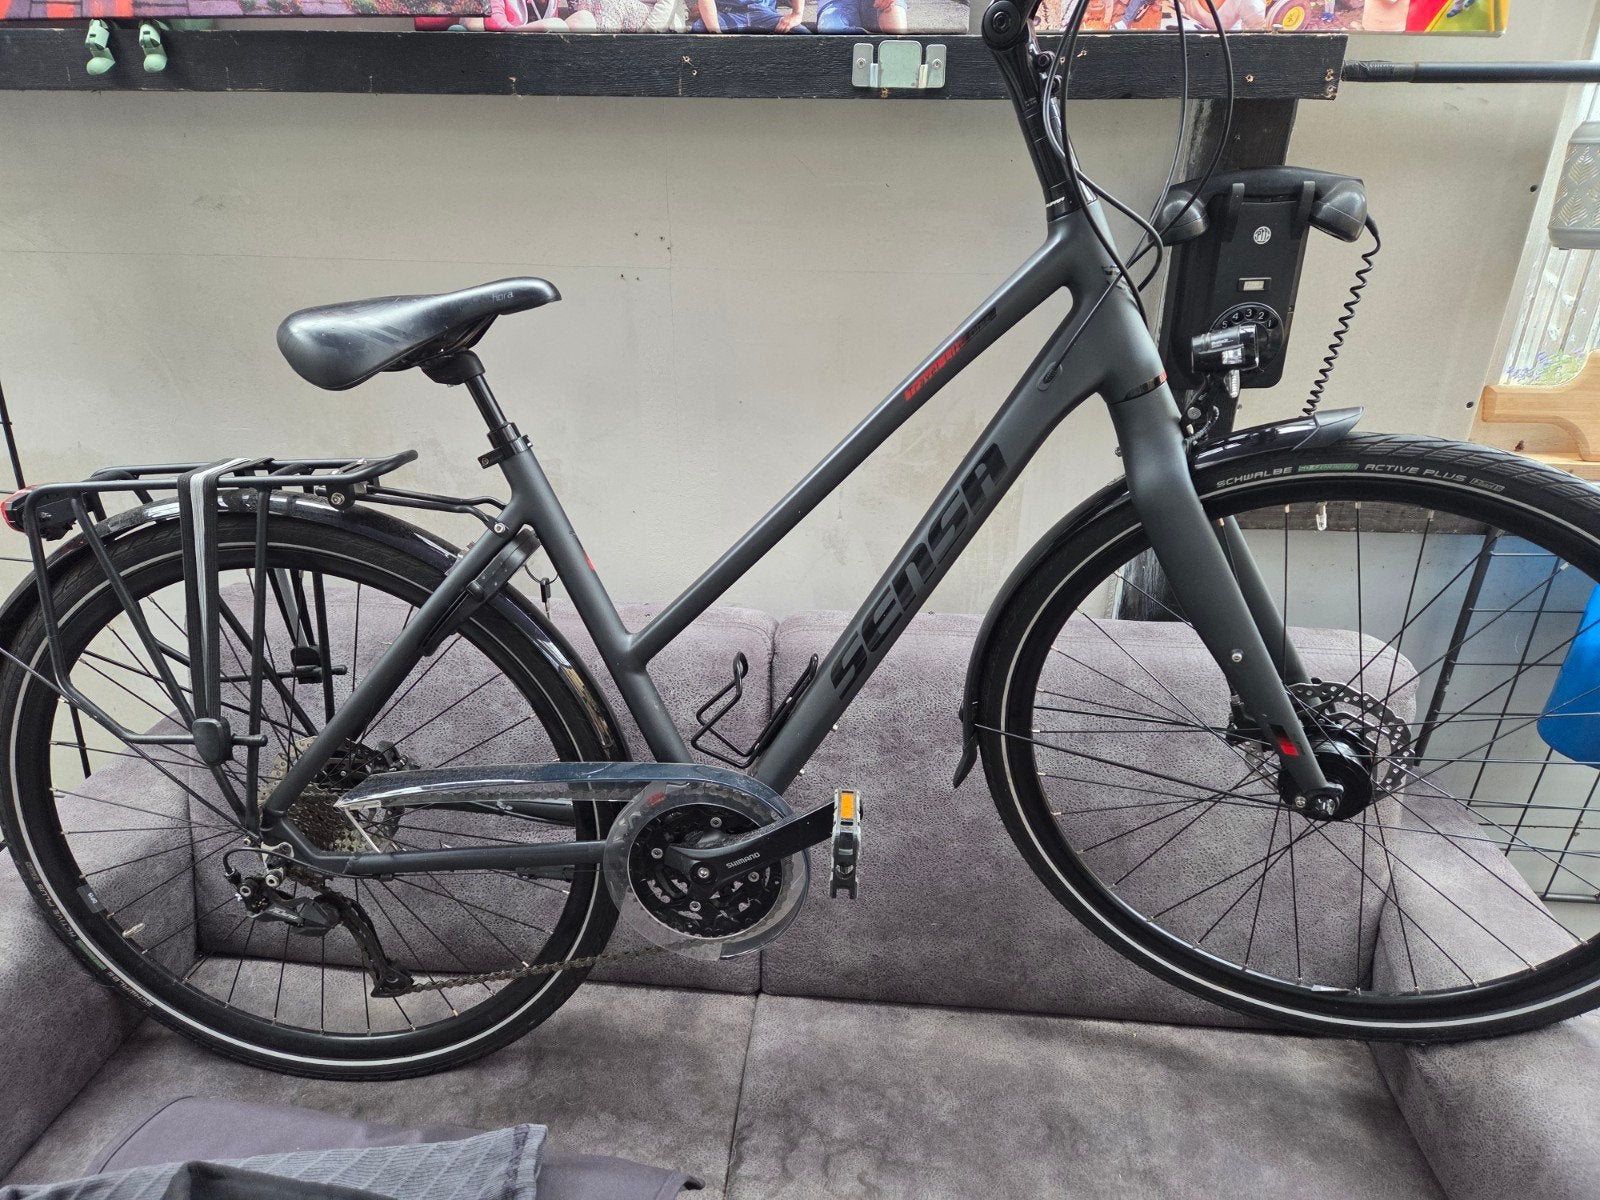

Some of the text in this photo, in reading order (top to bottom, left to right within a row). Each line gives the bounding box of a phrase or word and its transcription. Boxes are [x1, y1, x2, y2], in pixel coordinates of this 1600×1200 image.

[1232, 312, 1239, 320] 4
[1246, 308, 1252, 317] 3
[1258, 311, 1264, 320] 2
[1216, 466, 1293, 488] SCHWALBE
[1364, 463, 1420, 474] ACTIVE
[1422, 468, 1467, 482] PLUS
[831, 442, 1008, 700] SENSA
[725, 851, 761, 869] SHIMANO
